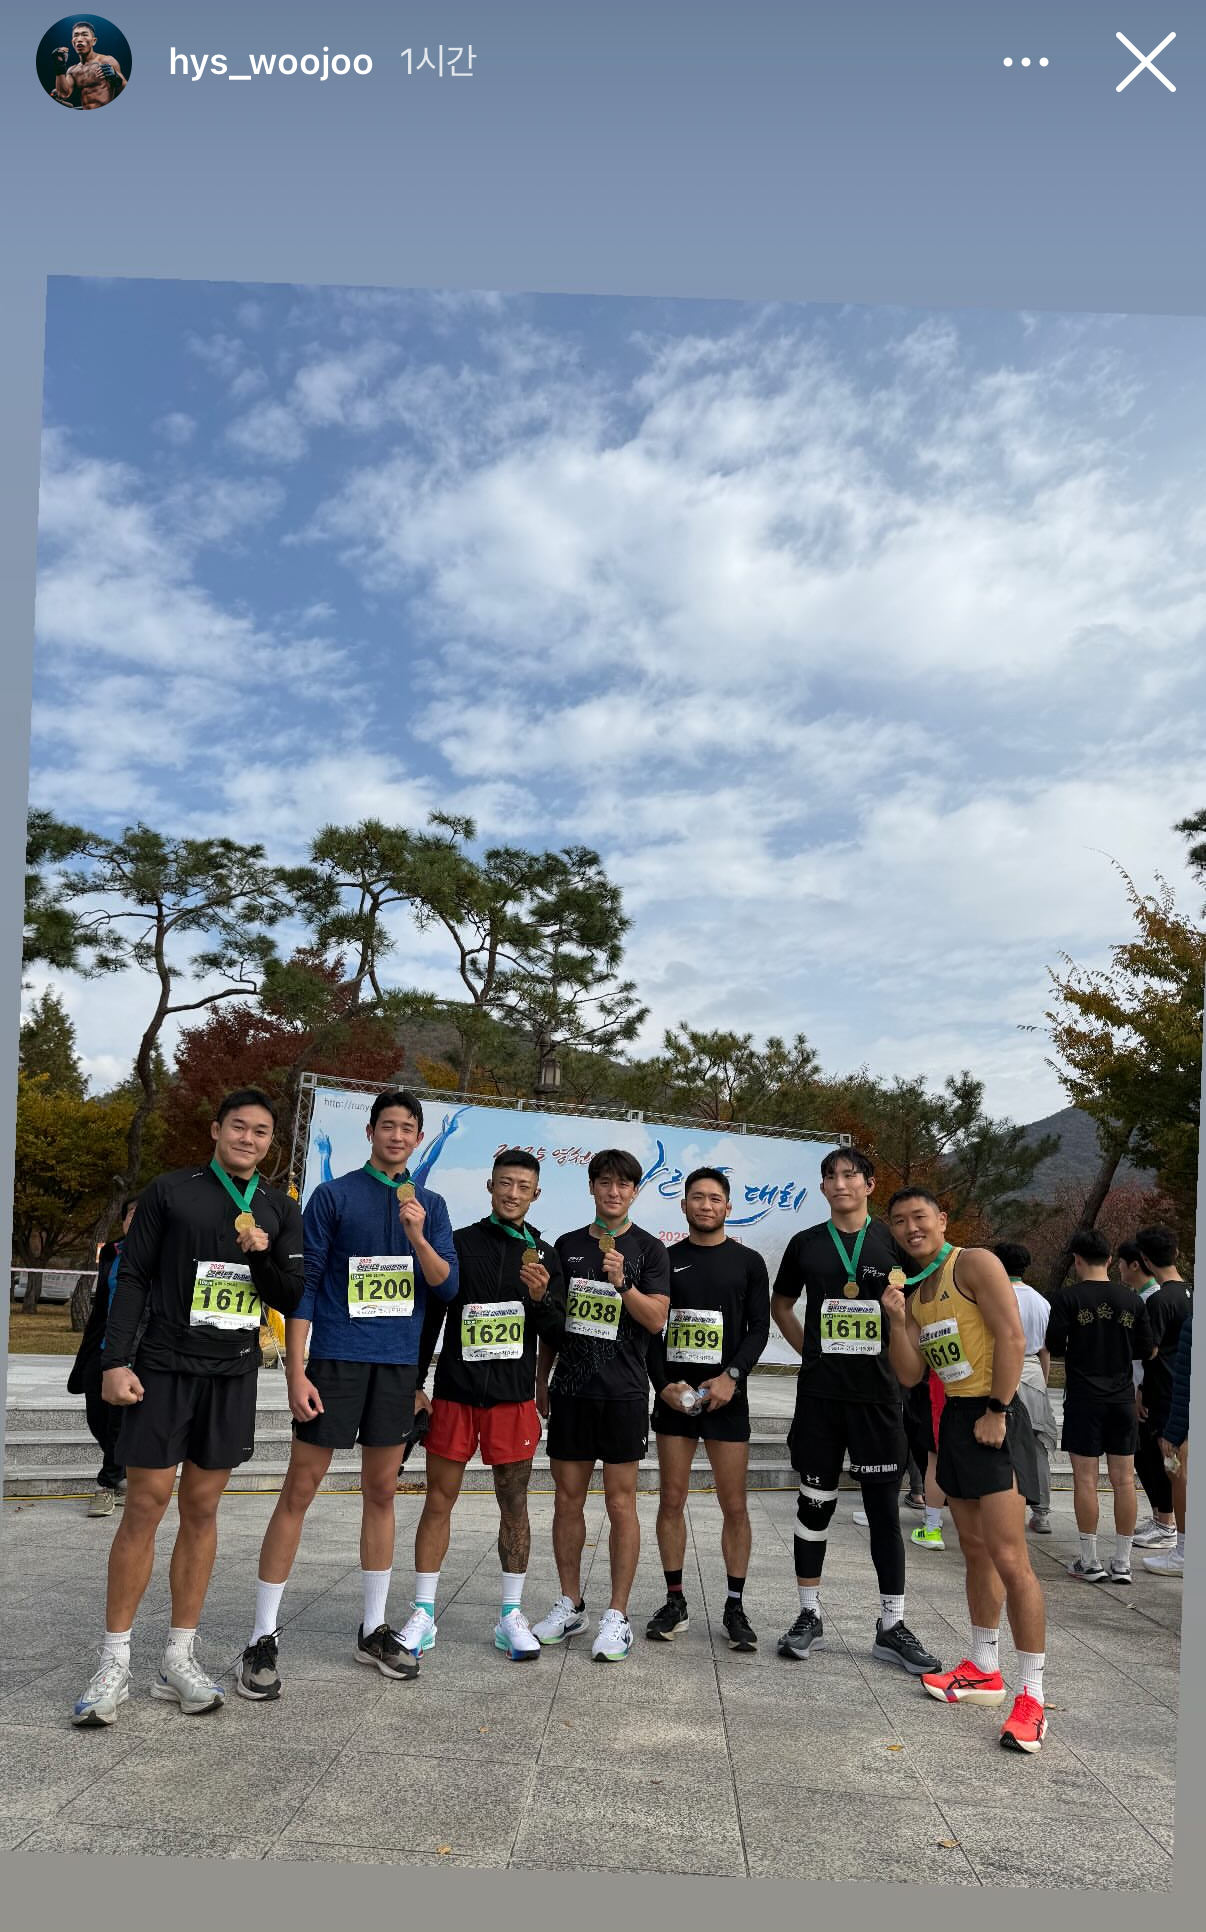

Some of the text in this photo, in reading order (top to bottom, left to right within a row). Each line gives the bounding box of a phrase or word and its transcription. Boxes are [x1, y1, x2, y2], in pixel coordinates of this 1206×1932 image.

[552, 1147, 597, 1166] 영천
[744, 1181, 808, 1210] 대회
[201, 1287, 258, 1313] 1617
[355, 1279, 411, 1300] 1200
[568, 1298, 617, 1323] 2038
[467, 1323, 520, 1345] 1620
[672, 1329, 719, 1348] 1199
[826, 1320, 877, 1339] 1618
